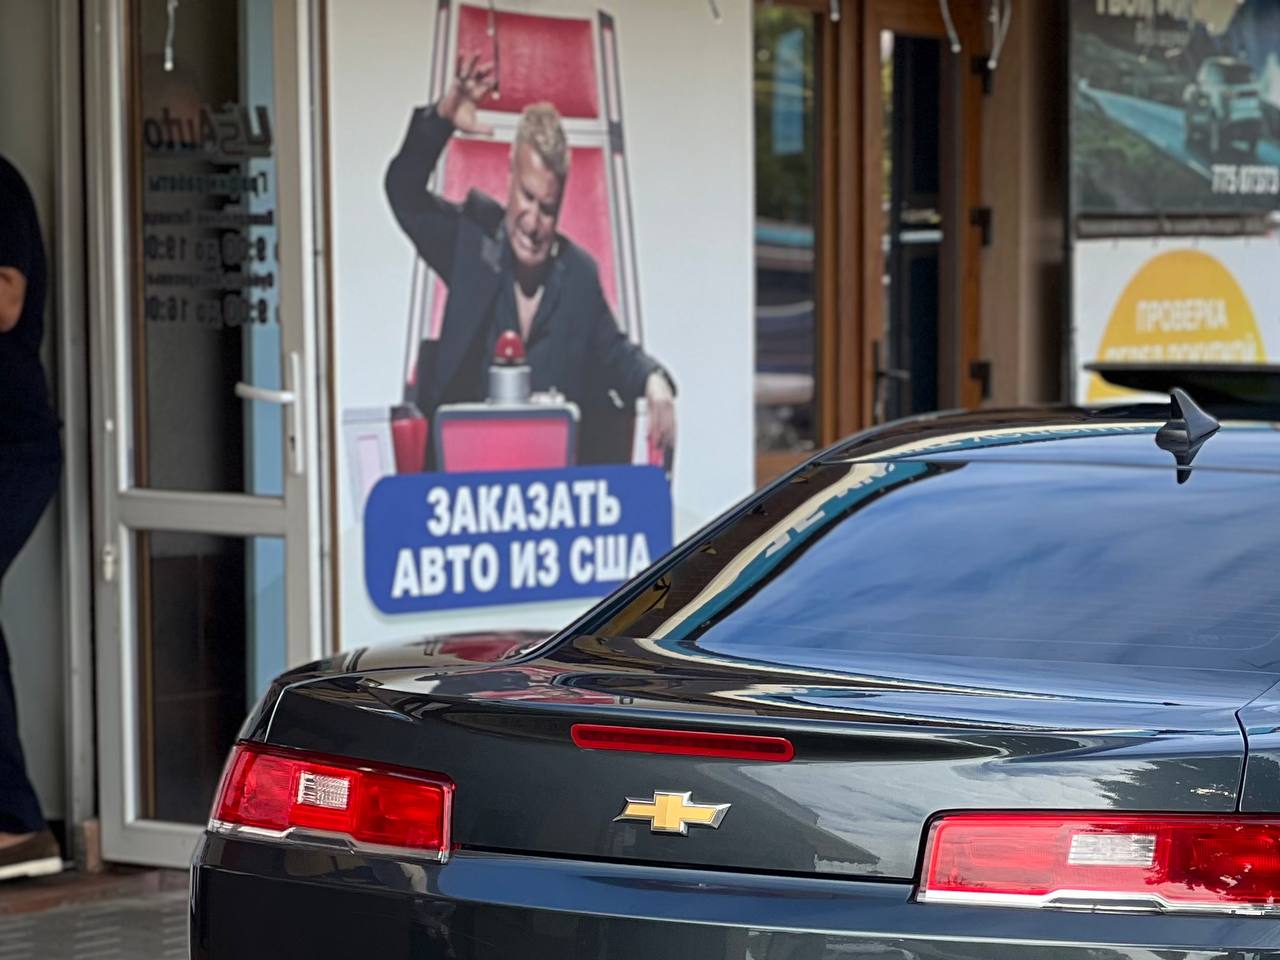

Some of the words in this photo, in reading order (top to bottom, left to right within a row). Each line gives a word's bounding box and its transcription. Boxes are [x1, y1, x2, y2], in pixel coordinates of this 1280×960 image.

[1136, 298, 1228, 333] ПРОВЕРКА
[426, 479, 622, 537] ЗАКАЗАТЬ
[390, 542, 500, 599] АВТО
[510, 538, 560, 590] ИЗ
[569, 533, 651, 584] США
